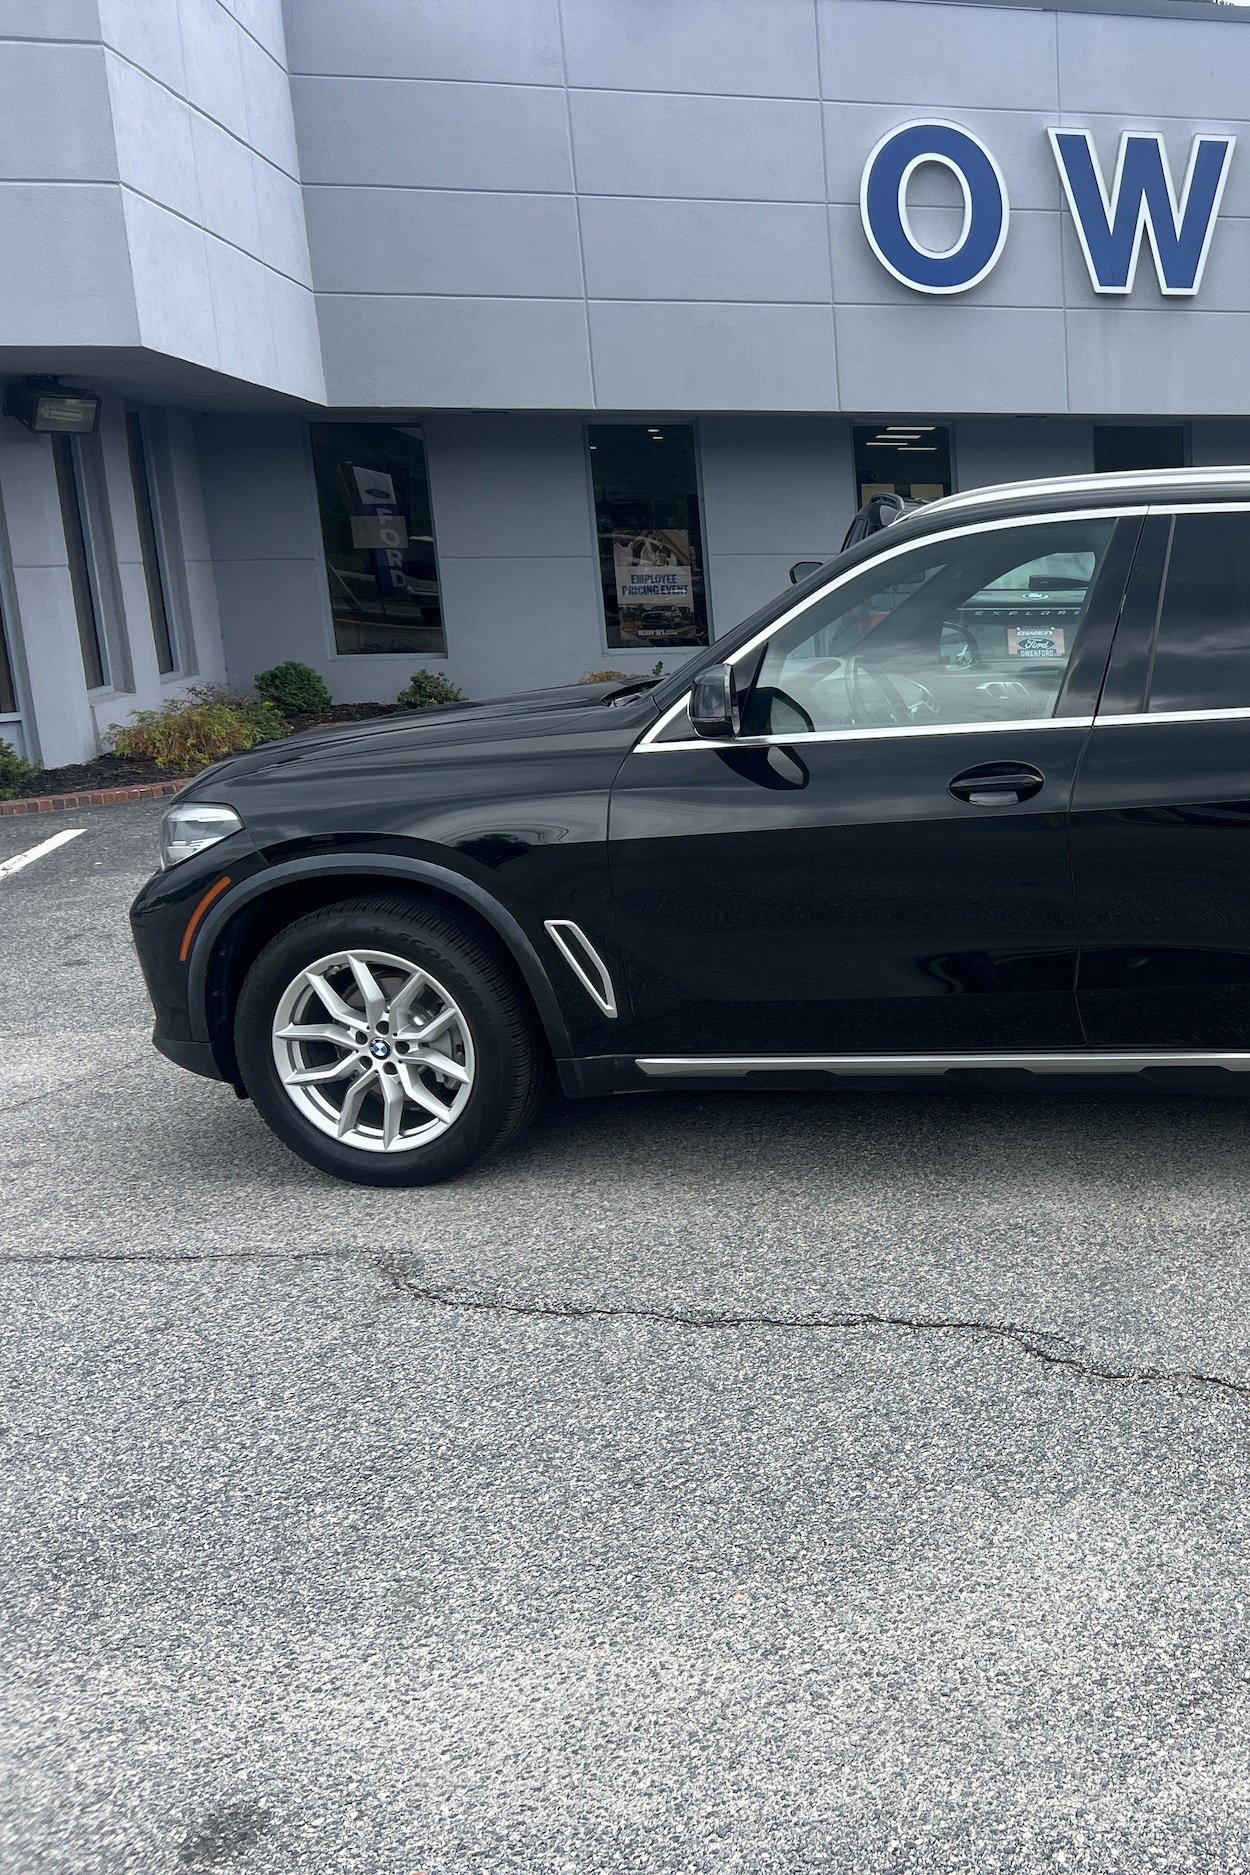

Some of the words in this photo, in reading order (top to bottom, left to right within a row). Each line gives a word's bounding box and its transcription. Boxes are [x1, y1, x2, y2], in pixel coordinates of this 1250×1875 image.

[376, 507, 406, 588] FORD
[631, 574, 677, 584] EMPLOYEE
[622, 585, 659, 596] PRICING
[661, 584, 688, 595] EVENT
[1025, 638, 1049, 649] Ford
